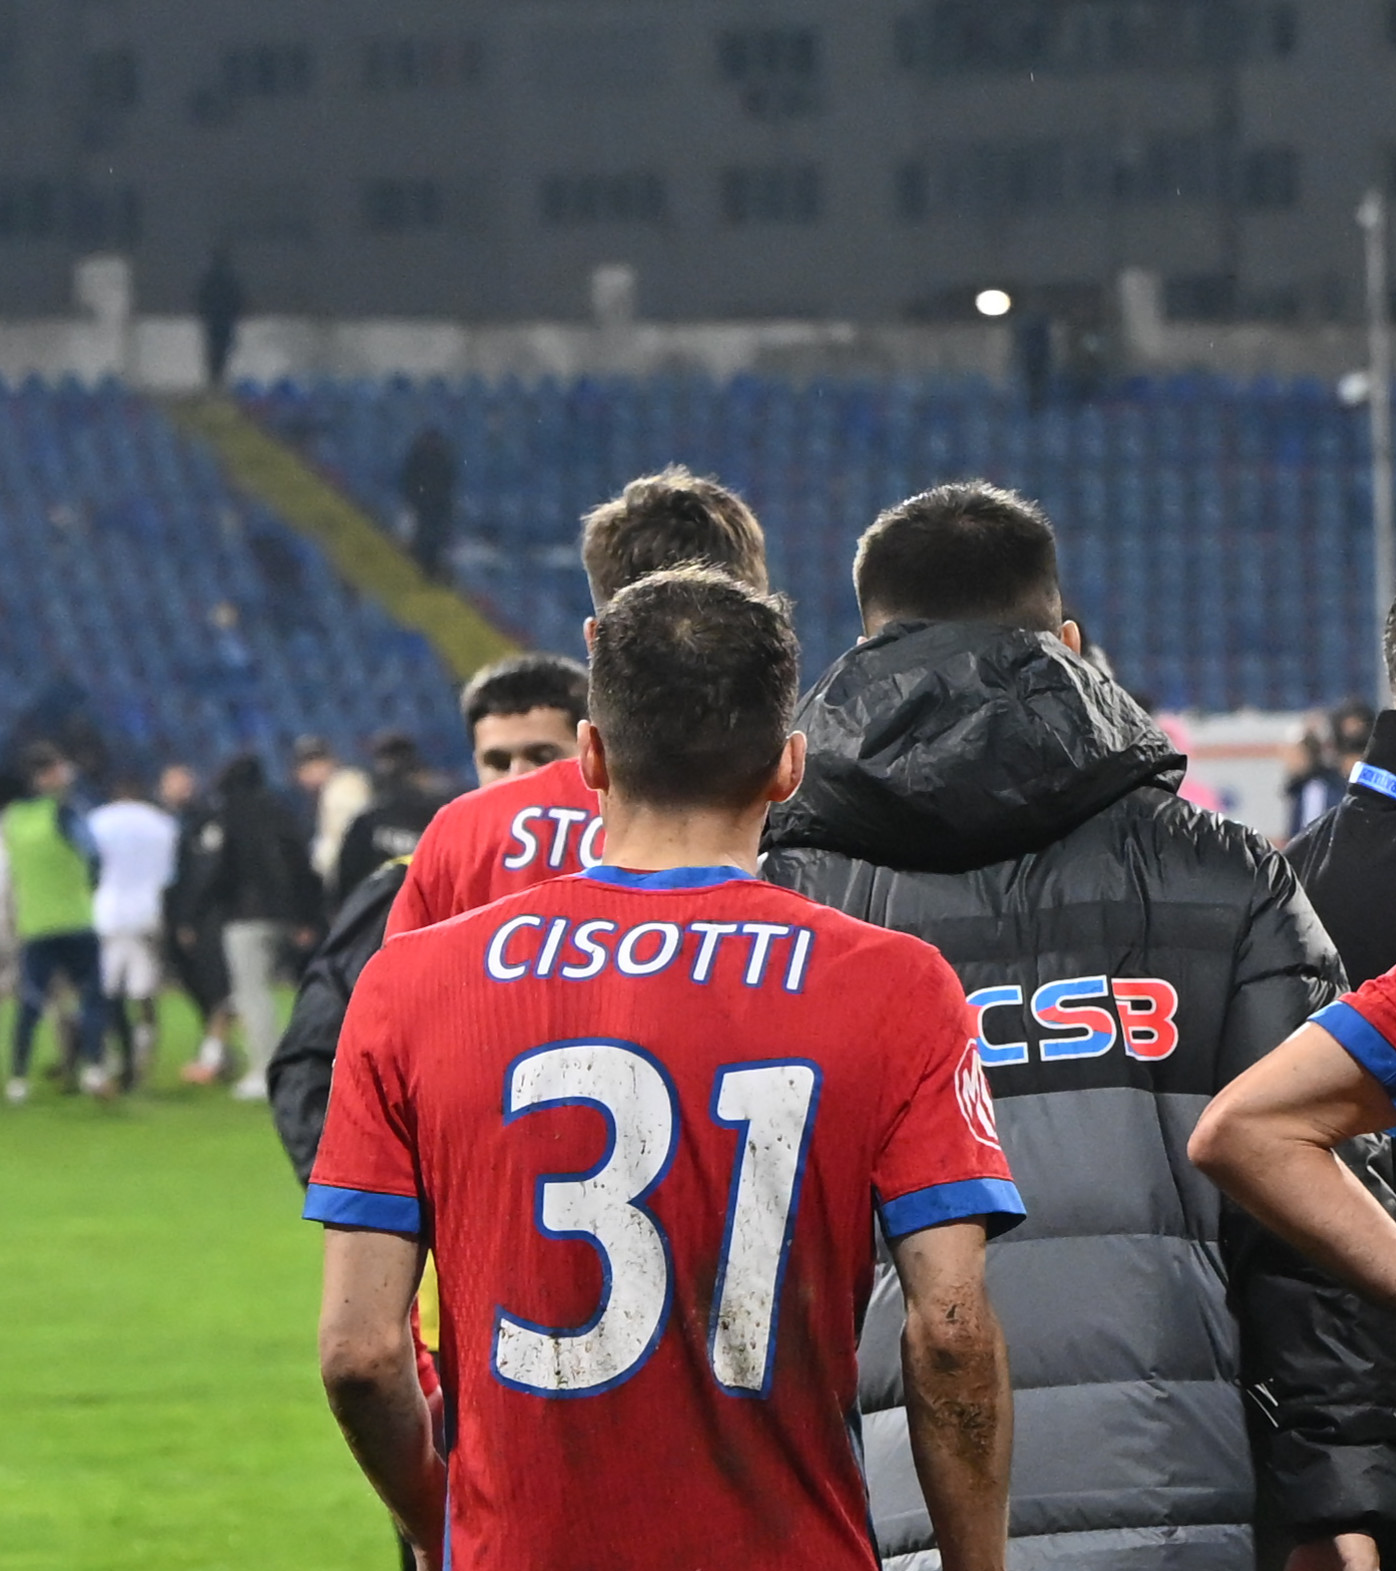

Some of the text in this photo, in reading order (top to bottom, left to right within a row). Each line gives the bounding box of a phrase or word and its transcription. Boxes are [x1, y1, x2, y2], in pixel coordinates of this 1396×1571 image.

[484, 913, 816, 995] CISOTTI
[964, 974, 1180, 1067] CSB
[490, 1037, 824, 1401] 31
